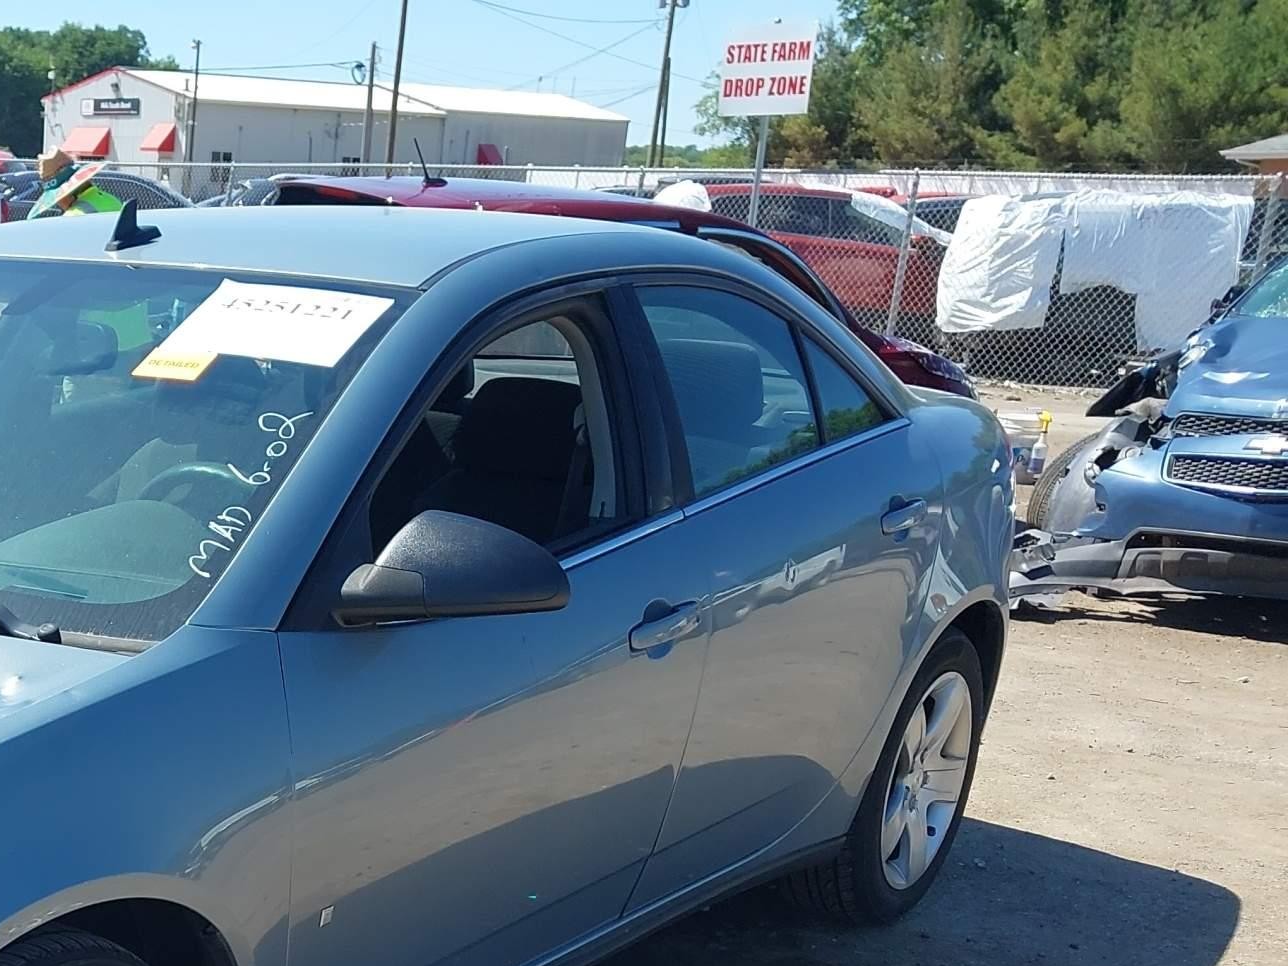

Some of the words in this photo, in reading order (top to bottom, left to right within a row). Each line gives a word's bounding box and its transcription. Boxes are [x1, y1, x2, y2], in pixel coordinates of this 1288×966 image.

[726, 43, 768, 64] STATE
[771, 41, 811, 62] FARM
[723, 77, 765, 97] DROP
[768, 75, 807, 96] ZONE
[188, 506, 252, 578] MAD
